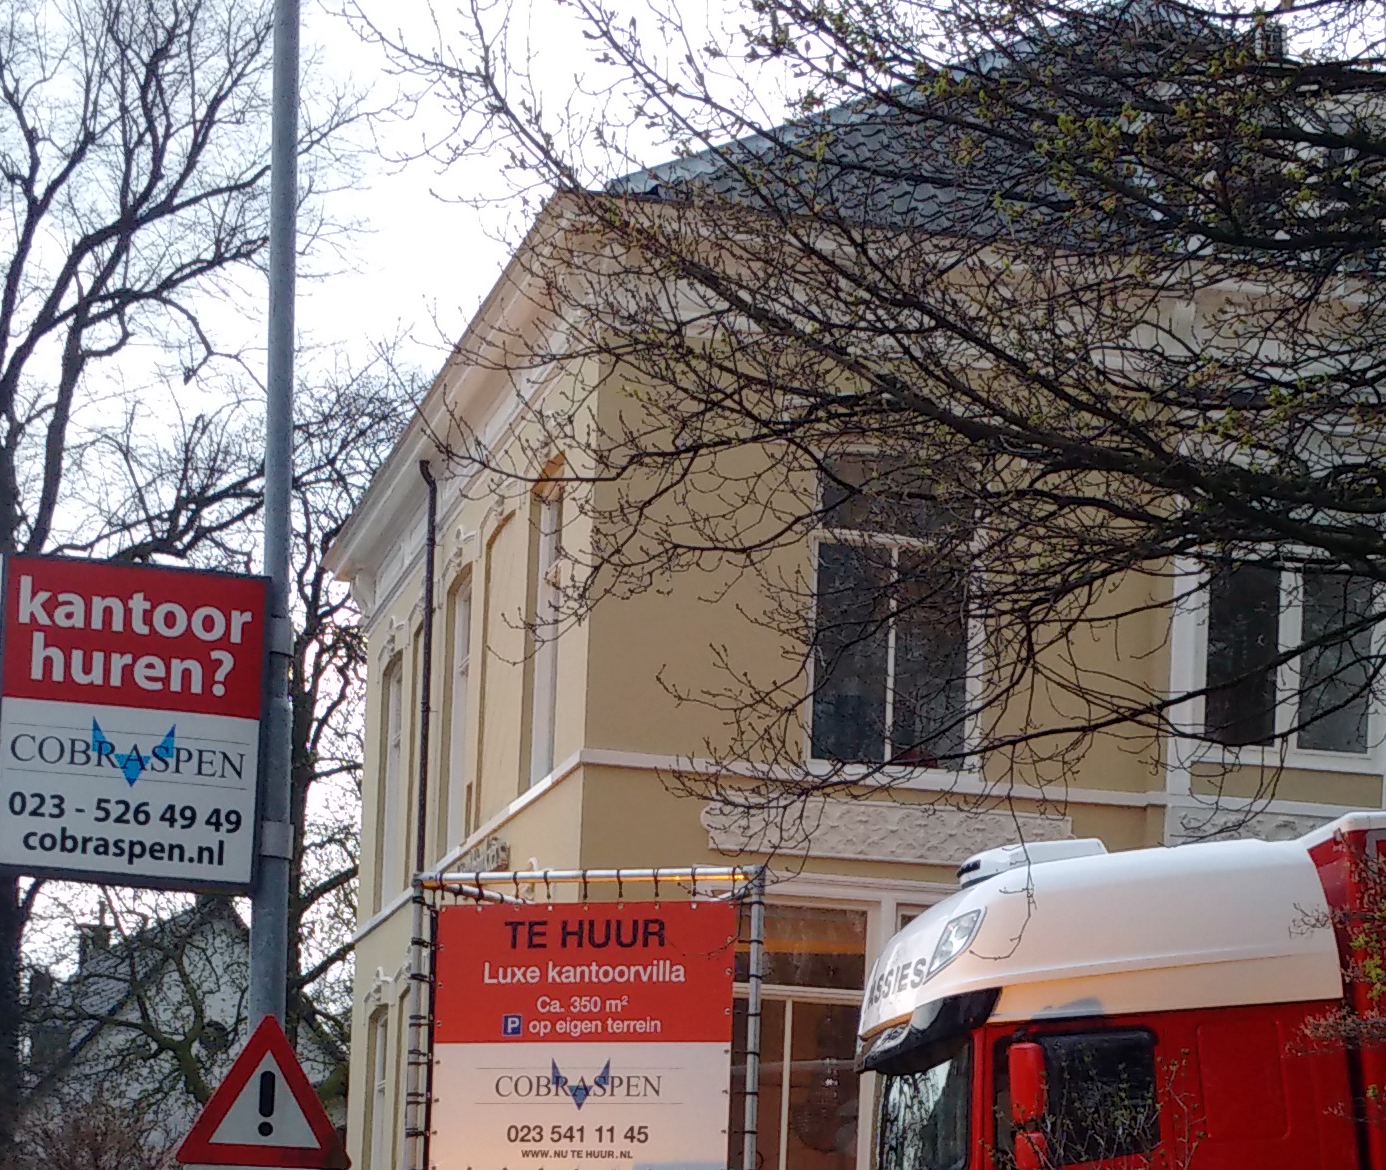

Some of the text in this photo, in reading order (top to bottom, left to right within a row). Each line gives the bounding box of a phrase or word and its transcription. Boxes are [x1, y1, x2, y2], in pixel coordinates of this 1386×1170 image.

[18, 574, 253, 645] kantoor
[30, 631, 235, 698] huren?
[10, 732, 247, 780] COBRASPEN
[8, 791, 67, 819] 023
[93, 798, 151, 827] 526
[159, 803, 198, 830] 49
[205, 807, 243, 834] 49
[22, 827, 226, 866] cobraspen.nl
[504, 918, 666, 949] TE HUUR
[483, 959, 687, 984] Luxe kantoorvilla
[536, 996, 565, 1013] Ca.
[570, 996, 601, 1013] 350
[528, 1019, 551, 1036] op
[555, 1016, 602, 1036] eigen
[607, 1016, 662, 1033] terrein
[495, 1075, 662, 1098] COBRASPEN
[506, 1125, 650, 1144] 023 541 11 45
